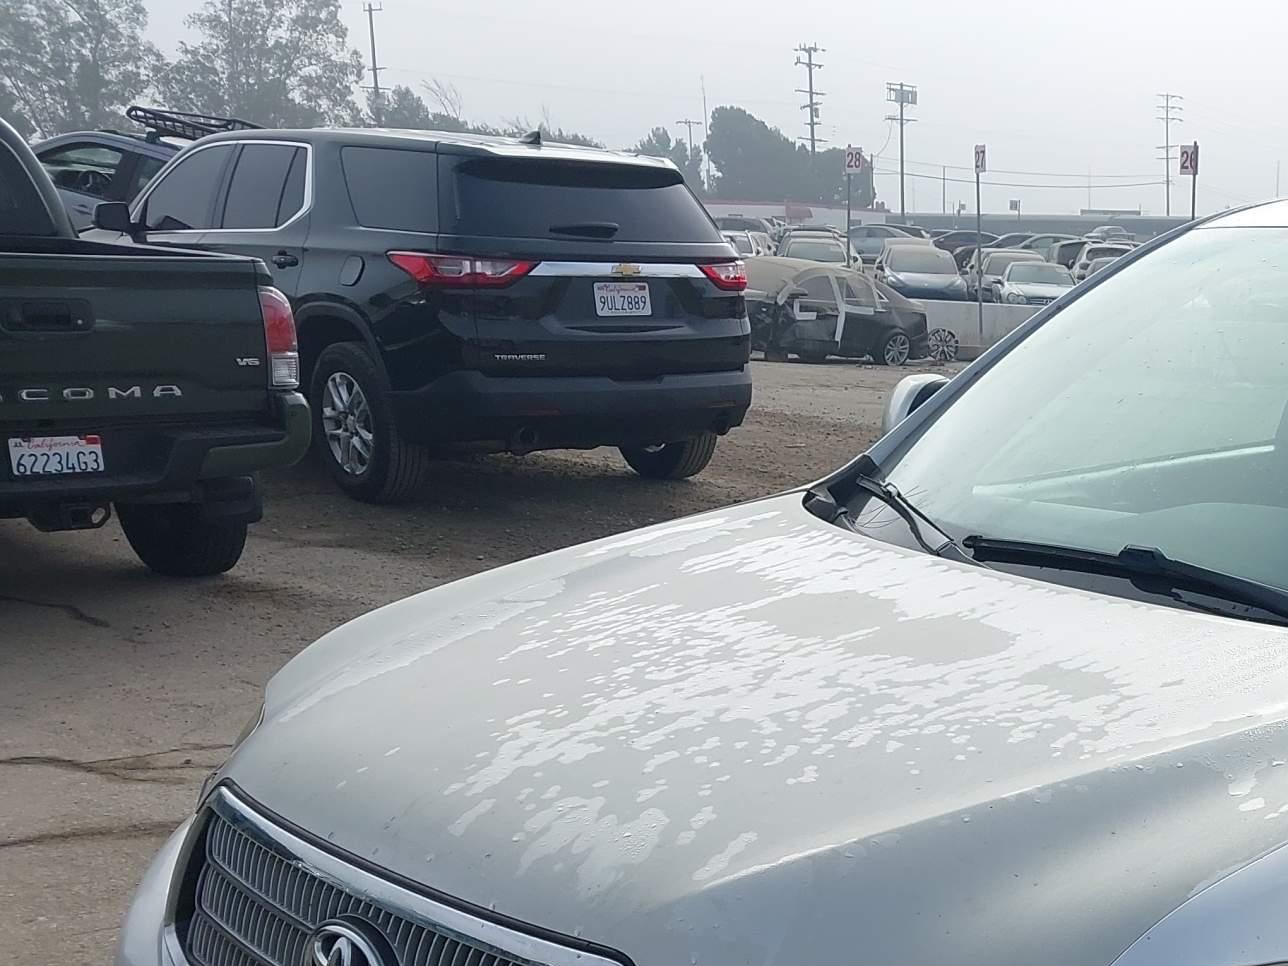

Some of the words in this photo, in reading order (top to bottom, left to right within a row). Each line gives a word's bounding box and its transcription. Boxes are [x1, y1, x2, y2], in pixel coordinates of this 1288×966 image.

[846, 151, 861, 169] 28
[975, 150, 985, 168] 27
[599, 295, 647, 311] 9ULZ889
[236, 358, 260, 366] V6
[16, 450, 100, 474] 62234G3
